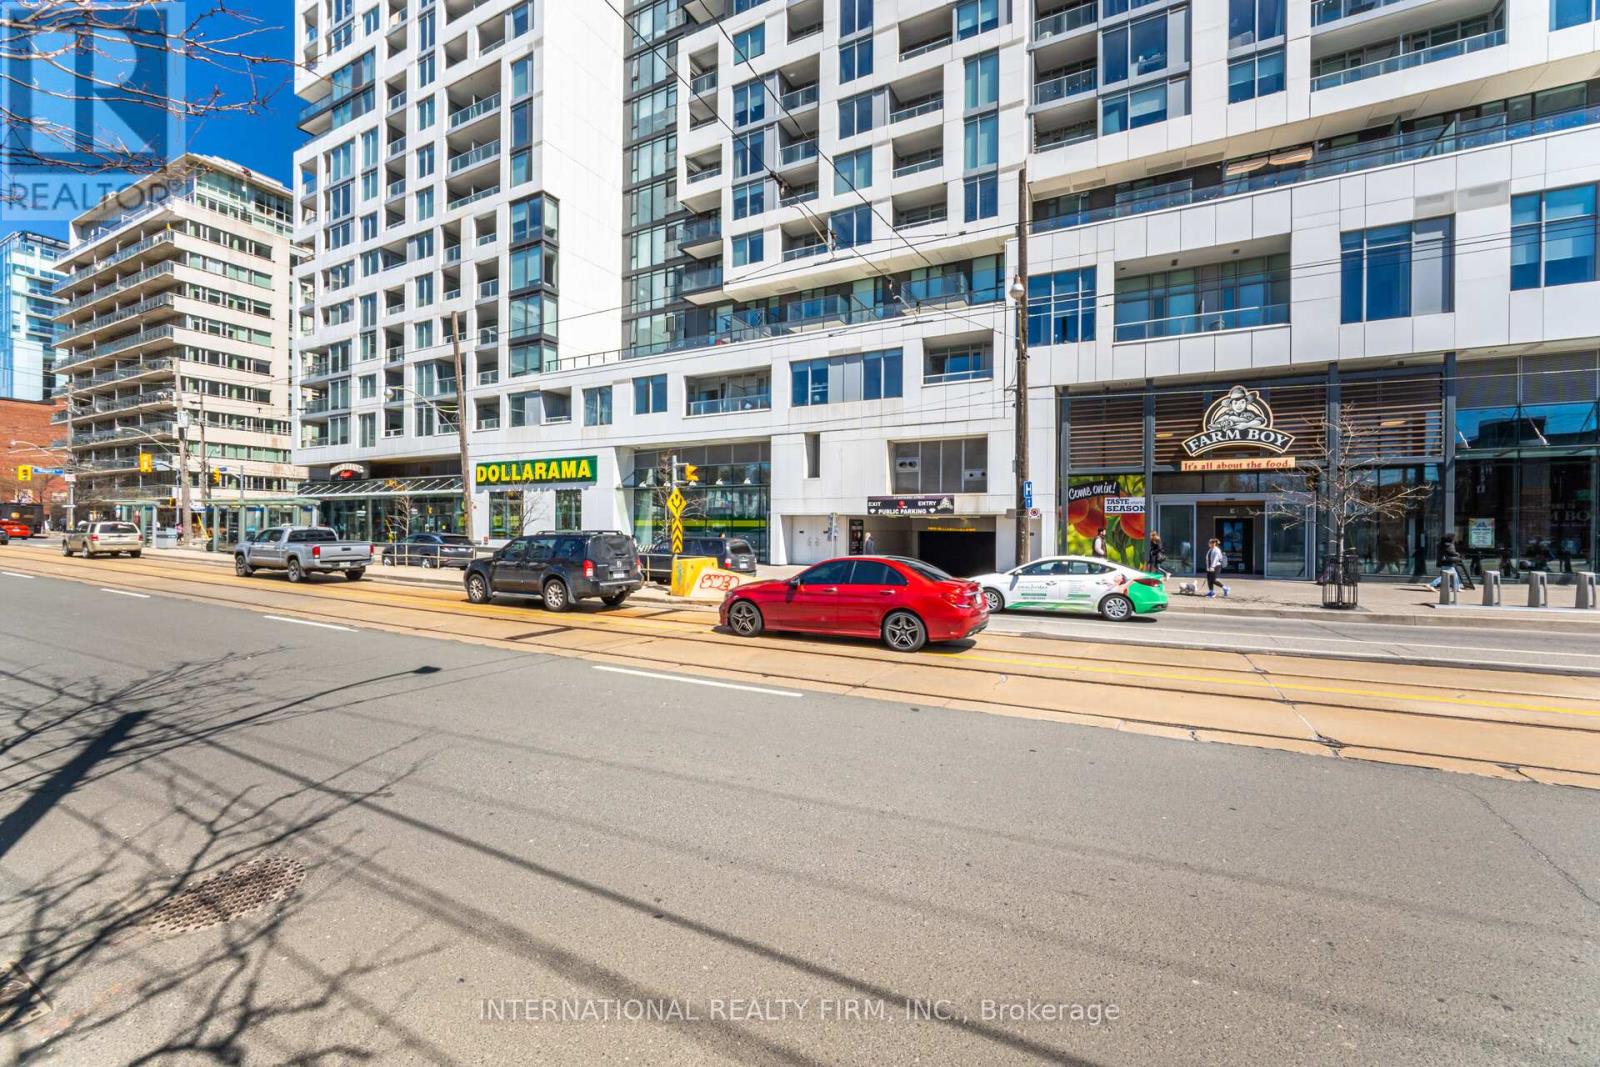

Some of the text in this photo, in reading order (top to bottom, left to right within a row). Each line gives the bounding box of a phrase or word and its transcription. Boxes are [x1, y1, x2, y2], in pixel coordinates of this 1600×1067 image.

[1187, 428, 1290, 452] FARM BOY
[476, 459, 592, 482] DOLLARAMA
[1184, 462, 1197, 471] It's
[1201, 462, 1213, 470] all
[1217, 461, 1242, 470] about
[1246, 460, 1263, 469] the
[1068, 486, 1092, 500] Come
